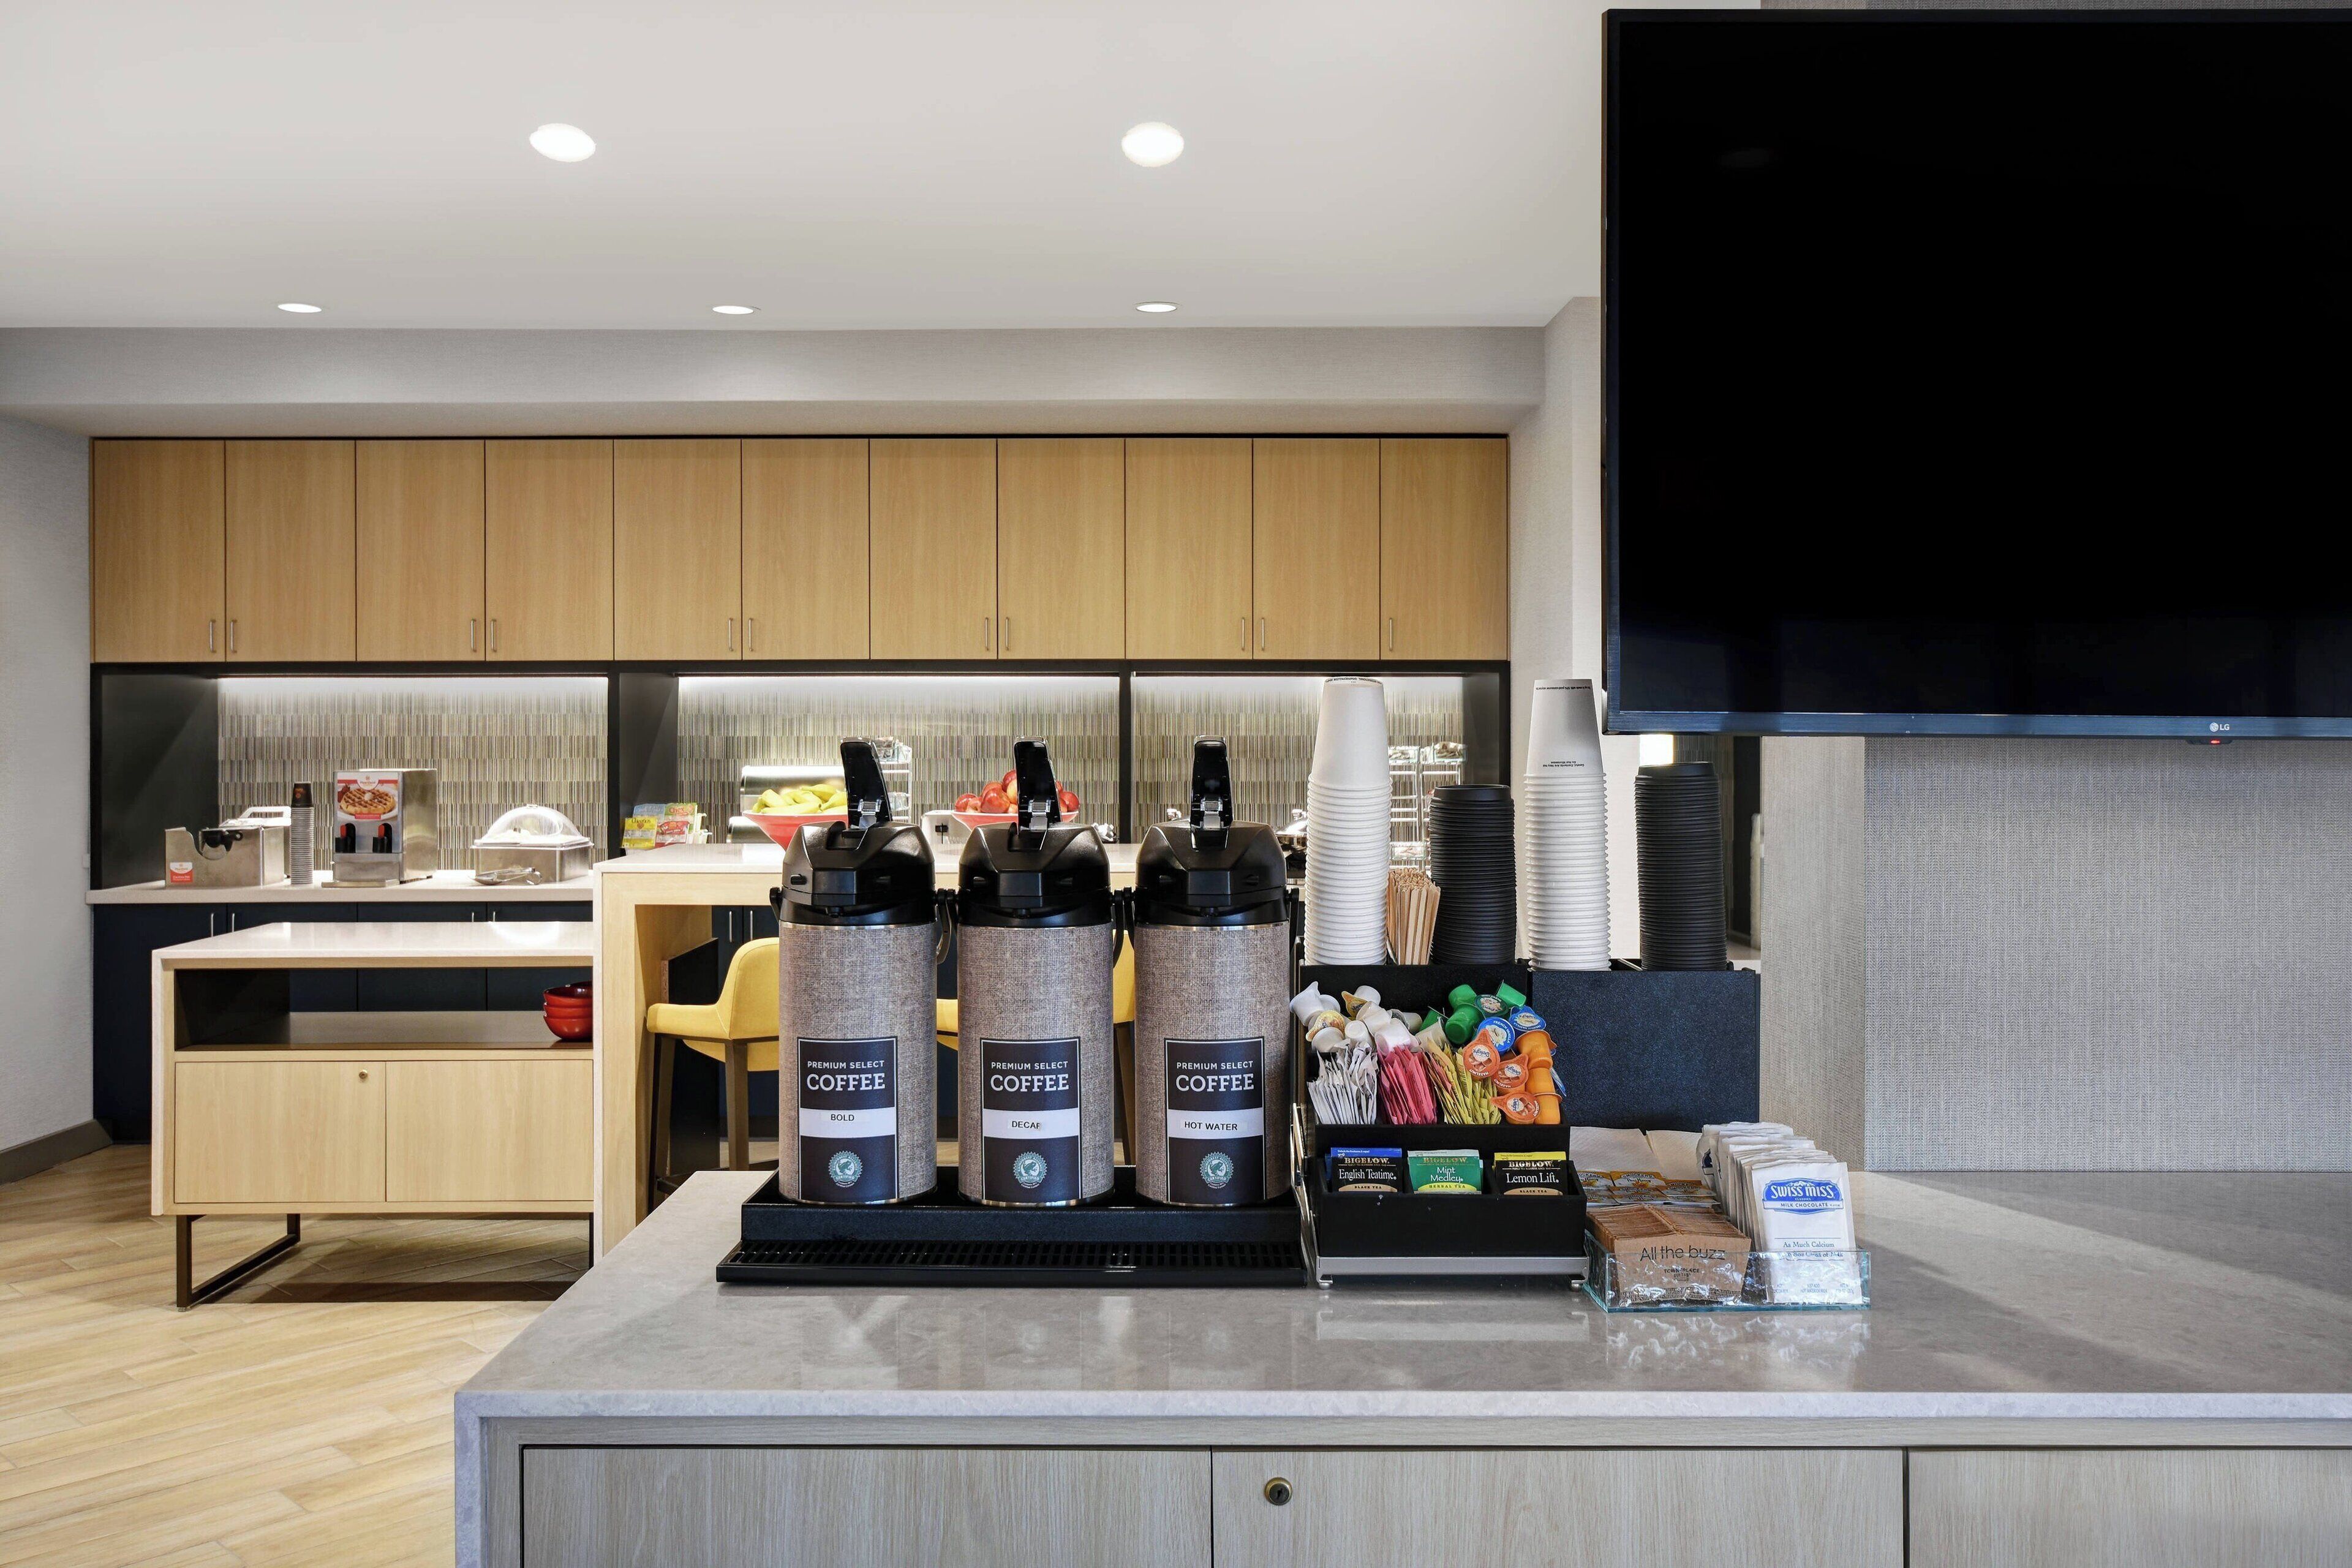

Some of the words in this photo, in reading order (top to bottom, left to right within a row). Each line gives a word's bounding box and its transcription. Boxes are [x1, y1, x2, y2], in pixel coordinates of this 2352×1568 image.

[1473, 1049, 1490, 1057] Delight
[850, 1060, 884, 1069] SELECT
[991, 1061, 1031, 1070] PREMIUM
[1035, 1061, 1068, 1069] SELECT
[1221, 1061, 1253, 1069] SELECT
[807, 1073, 886, 1091] COFFEE
[990, 1074, 1069, 1091] COFFEE
[1176, 1073, 1254, 1091] COFFEE
[1339, 1169, 1365, 1181] English
[1430, 1172, 1461, 1183] Medley
[1506, 1173, 1539, 1183] Lemon
[1539, 1172, 1556, 1183] Lift
[1640, 1246, 1656, 1261] All
[1660, 1246, 1684, 1259] the
[1689, 1245, 1725, 1260] buzz
